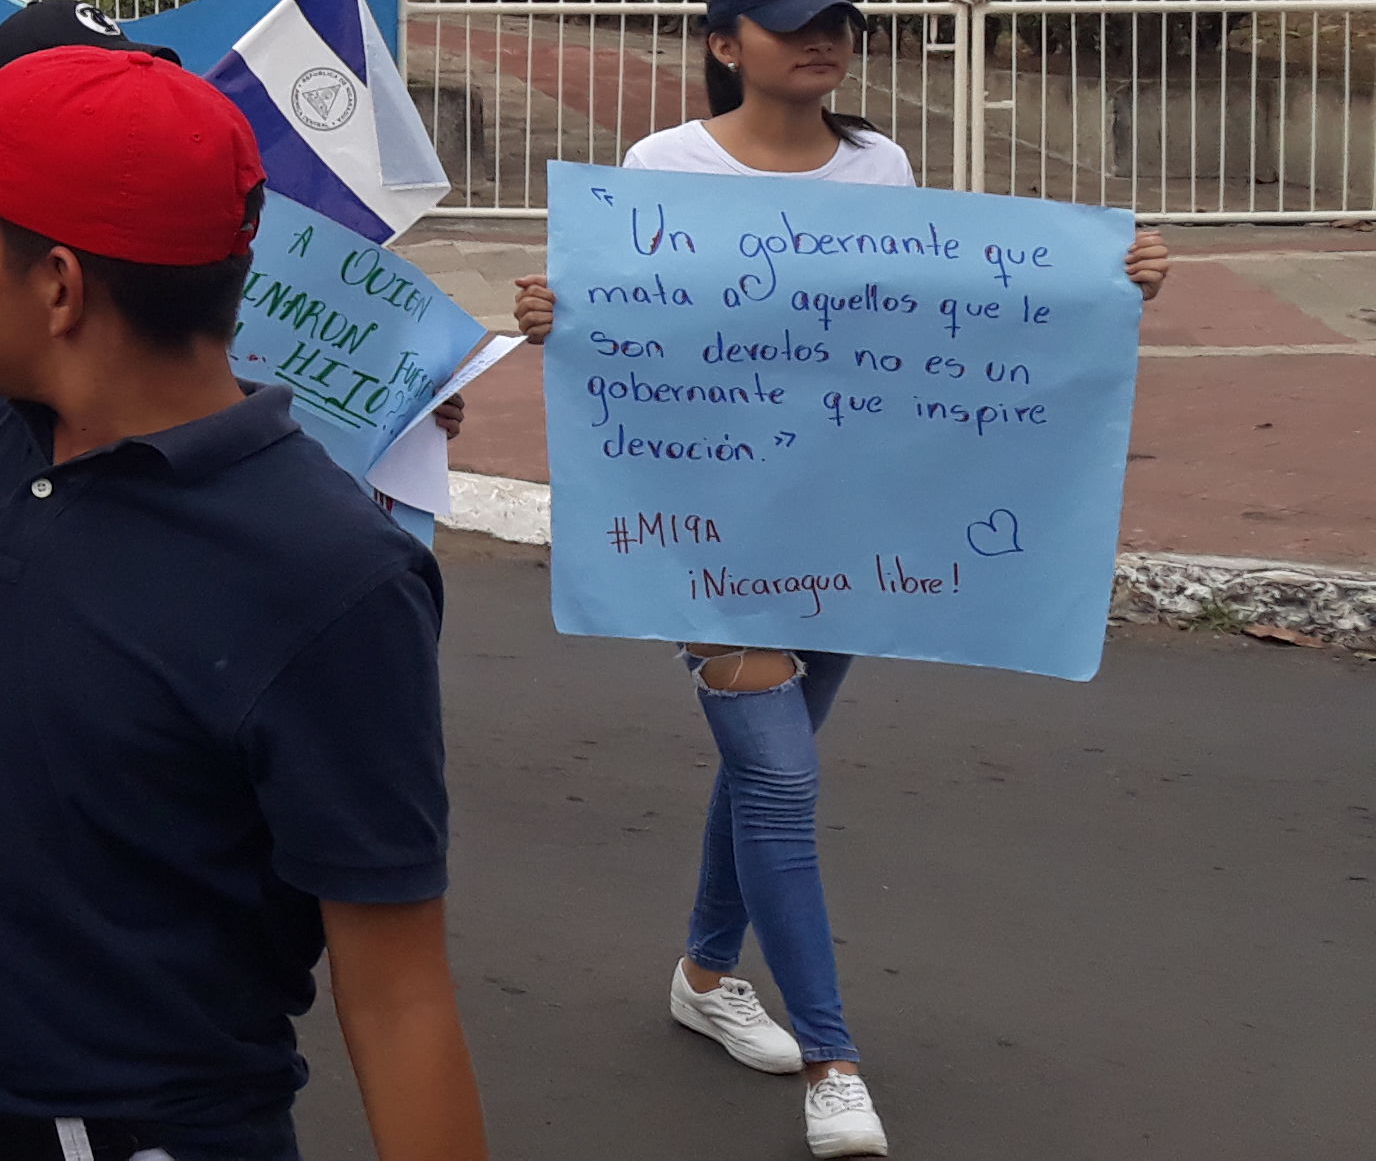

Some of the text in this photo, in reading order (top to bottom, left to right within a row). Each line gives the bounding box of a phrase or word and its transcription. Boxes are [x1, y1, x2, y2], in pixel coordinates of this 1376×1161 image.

[288, 225, 314, 258] A
[738, 211, 960, 302] gobernante
[984, 244, 1053, 289] que
[242, 271, 378, 356] INARON
[587, 273, 694, 306] mata
[791, 282, 918, 332] aquellos
[939, 298, 1000, 339] que
[1023, 294, 1051, 325] le
[702, 328, 830, 365] devotos
[854, 349, 902, 372] no
[924, 355, 965, 379] es
[985, 361, 1030, 385] un
[587, 371, 1048, 437] gobernante que inspire
[606, 511, 721, 555] #M19A
[875, 554, 959, 595] libre!
